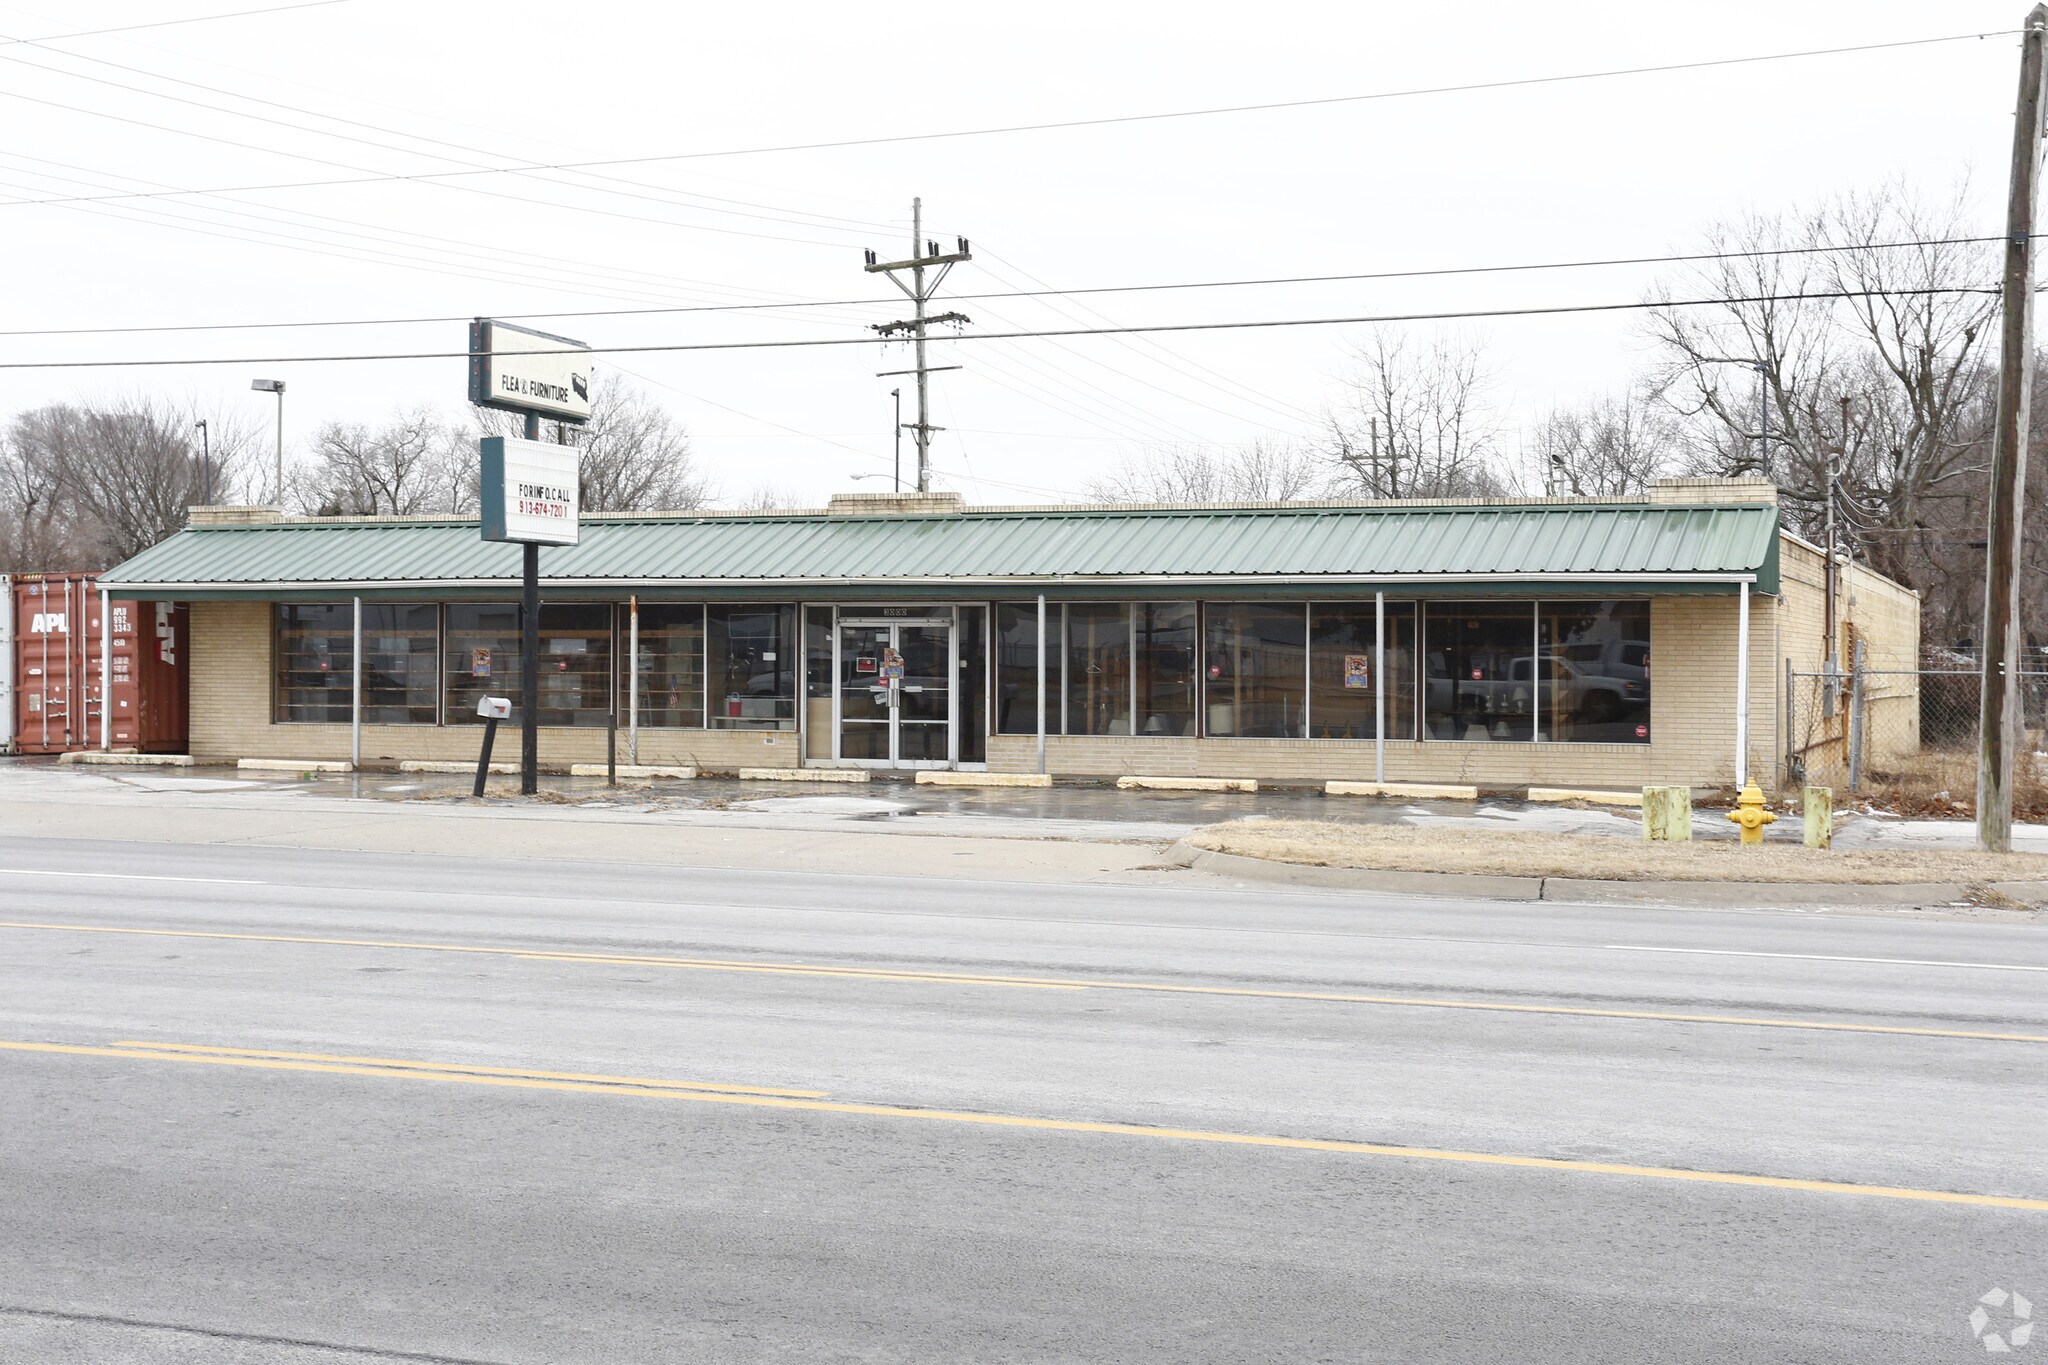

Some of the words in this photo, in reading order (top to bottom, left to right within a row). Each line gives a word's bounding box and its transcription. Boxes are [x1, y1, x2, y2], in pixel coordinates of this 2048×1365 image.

[502, 374, 520, 393] FLEA
[520, 378, 528, 395] &
[530, 380, 569, 403] FURNITURE
[519, 500, 567, 518] 913-674-7201
[113, 607, 127, 616] APLU
[113, 616, 127, 624] 992
[31, 613, 68, 633] APL
